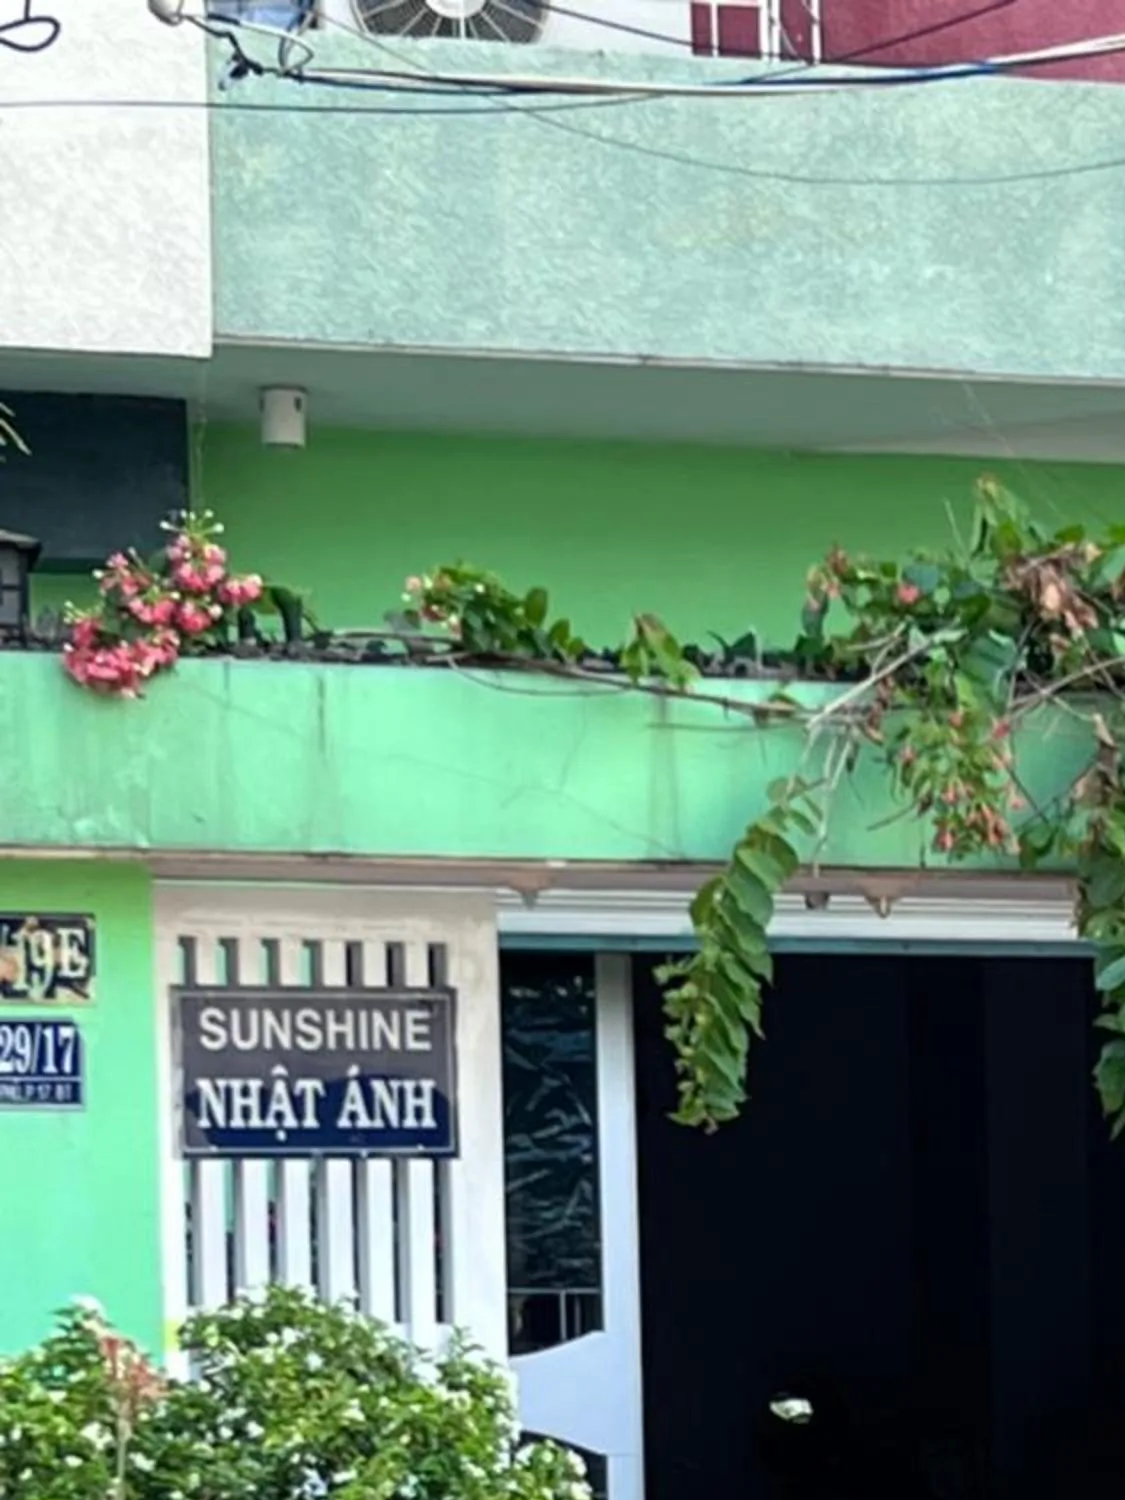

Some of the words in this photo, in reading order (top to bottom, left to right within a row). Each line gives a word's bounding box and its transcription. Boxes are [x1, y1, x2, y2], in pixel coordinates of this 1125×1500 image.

[200, 1007, 433, 1051] SUNSHINE
[195, 1064, 326, 1142] NHẬT
[336, 1064, 438, 1130] ÁNH
